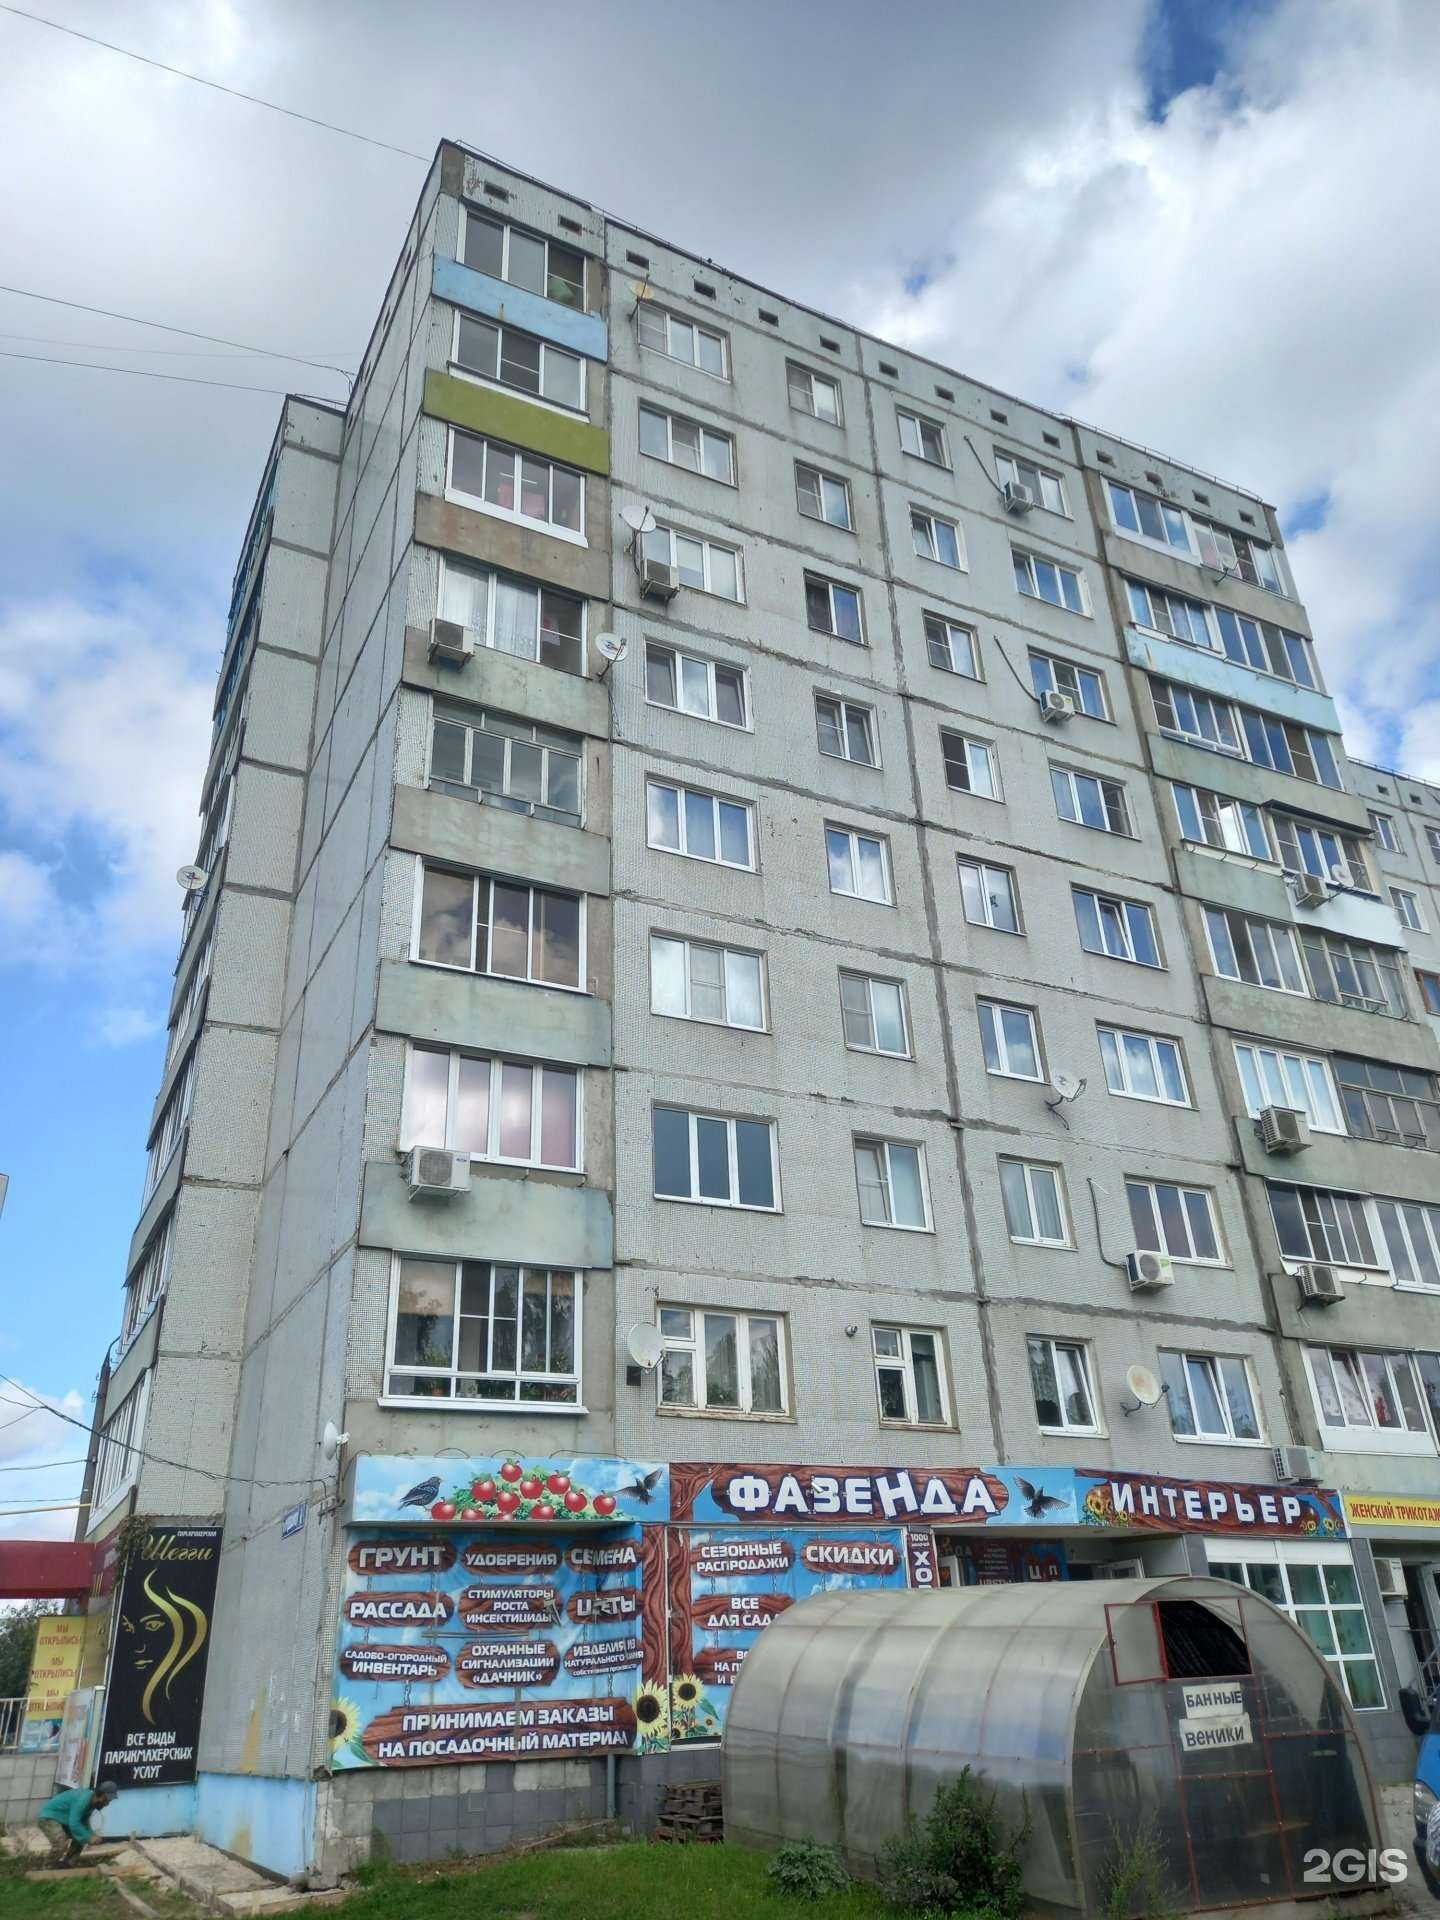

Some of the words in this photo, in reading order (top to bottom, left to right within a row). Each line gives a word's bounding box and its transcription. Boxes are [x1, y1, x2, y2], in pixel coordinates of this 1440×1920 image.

[727, 1469, 998, 1520] ФАЗЕНДА
[1110, 1480, 1302, 1524] ИНТЕРЬЕР
[1350, 1500, 1395, 1519] ЖЕНСКИЙ
[911, 1533, 929, 1542] 1000
[359, 1546, 445, 1568] ГРУНТ
[571, 1546, 637, 1565] СЕМЕНА
[701, 1543, 782, 1558] СЕЗОННЫЕ
[806, 1545, 895, 1566] СКИДКИ
[466, 1553, 557, 1566] УДОБРЕНИЯ
[696, 1557, 789, 1573] РАСПРОДАЖИ
[912, 1551, 933, 1589] ХО
[468, 1589, 554, 1599] СТИМУЛЯТОРЫ
[350, 1602, 448, 1619] РАССАДА
[493, 1601, 529, 1611] РОСТА
[731, 1597, 760, 1610] ВСЕ
[466, 1613, 552, 1624] ИНСЕКТИЦИДЫ
[707, 1614, 740, 1627] ДЛЯ
[742, 1614, 778, 1627] САД
[471, 1644, 546, 1656] ОХРАННЫЕ
[573, 1640, 626, 1657] ИЗДЕЛИЯ
[461, 1658, 554, 1669] СИГНАЛИЗАЦИИ
[564, 1654, 625, 1668] НАТУРАЛЬНОГО
[714, 1663, 730, 1671] НА
[352, 1662, 438, 1676] ИНВЕНТАРЬ
[473, 1671, 542, 1684] «ДАЧНИК»
[1185, 1691, 1243, 1708] БАННЫЕ
[402, 1710, 535, 1731] ПРИНИМАЕМ
[538, 1706, 614, 1725] ЗАКАЗЫ
[126, 1732, 146, 1746] ВСЕ
[147, 1731, 176, 1746] ВИДЫ
[378, 1742, 405, 1758] НА
[408, 1732, 539, 1757] ПОСАДОЧНЫЙ
[104, 1747, 193, 1765] ПАРИКМАХЕРСКИХ
[132, 1765, 163, 1780] УСЛУГ
